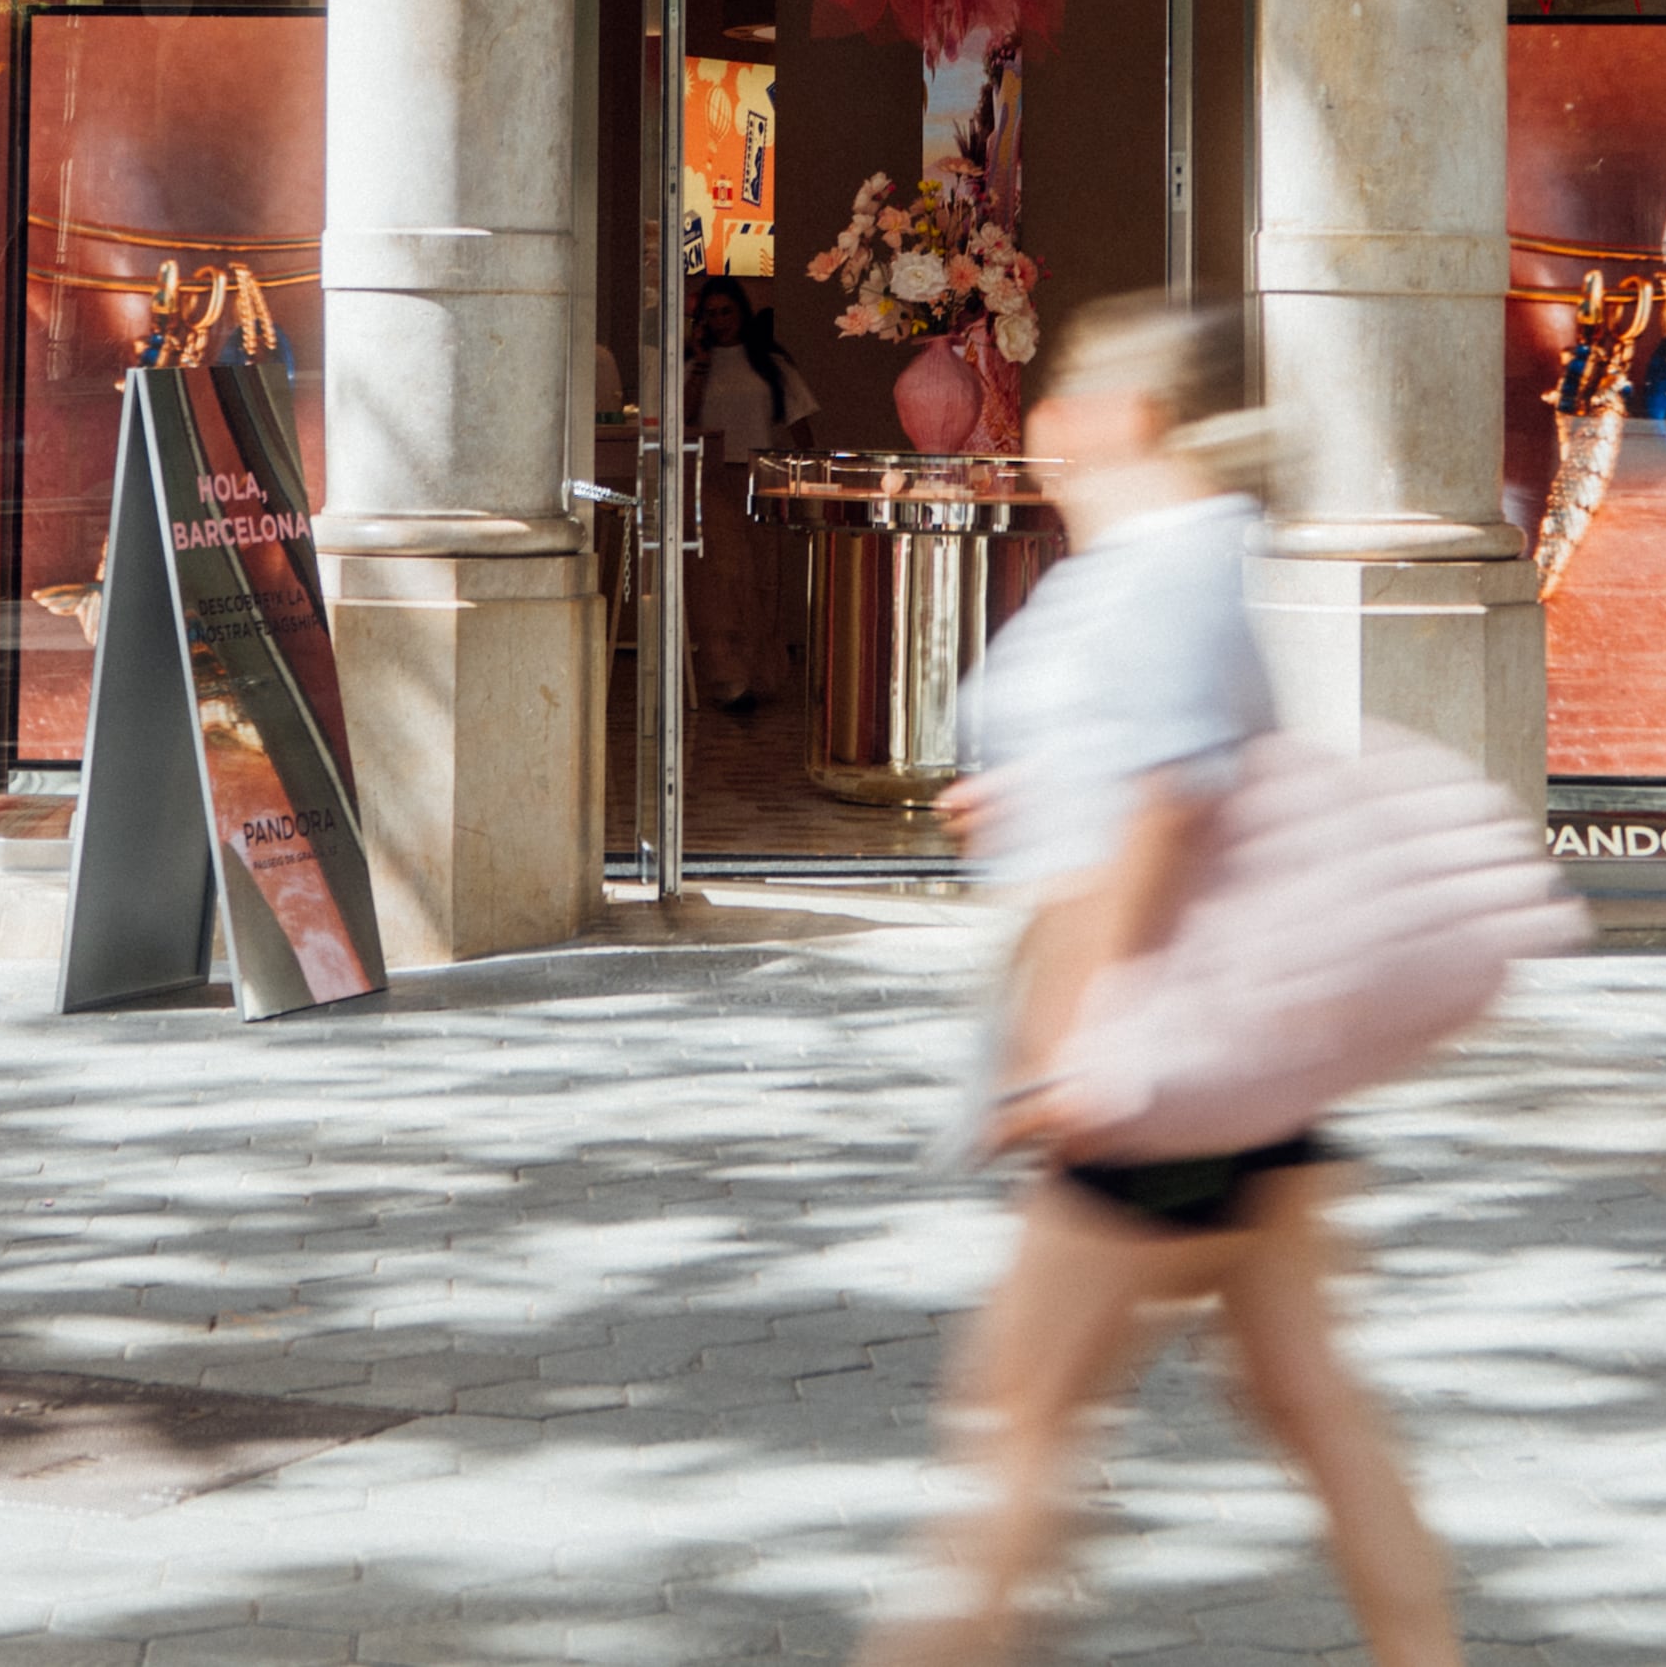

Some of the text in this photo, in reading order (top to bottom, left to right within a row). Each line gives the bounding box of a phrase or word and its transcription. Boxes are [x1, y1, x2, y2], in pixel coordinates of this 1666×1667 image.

[197, 471, 268, 504] HOLA,
[172, 510, 312, 551] BARCELONA
[288, 588, 305, 604] LA
[243, 807, 336, 847] PANDORA
